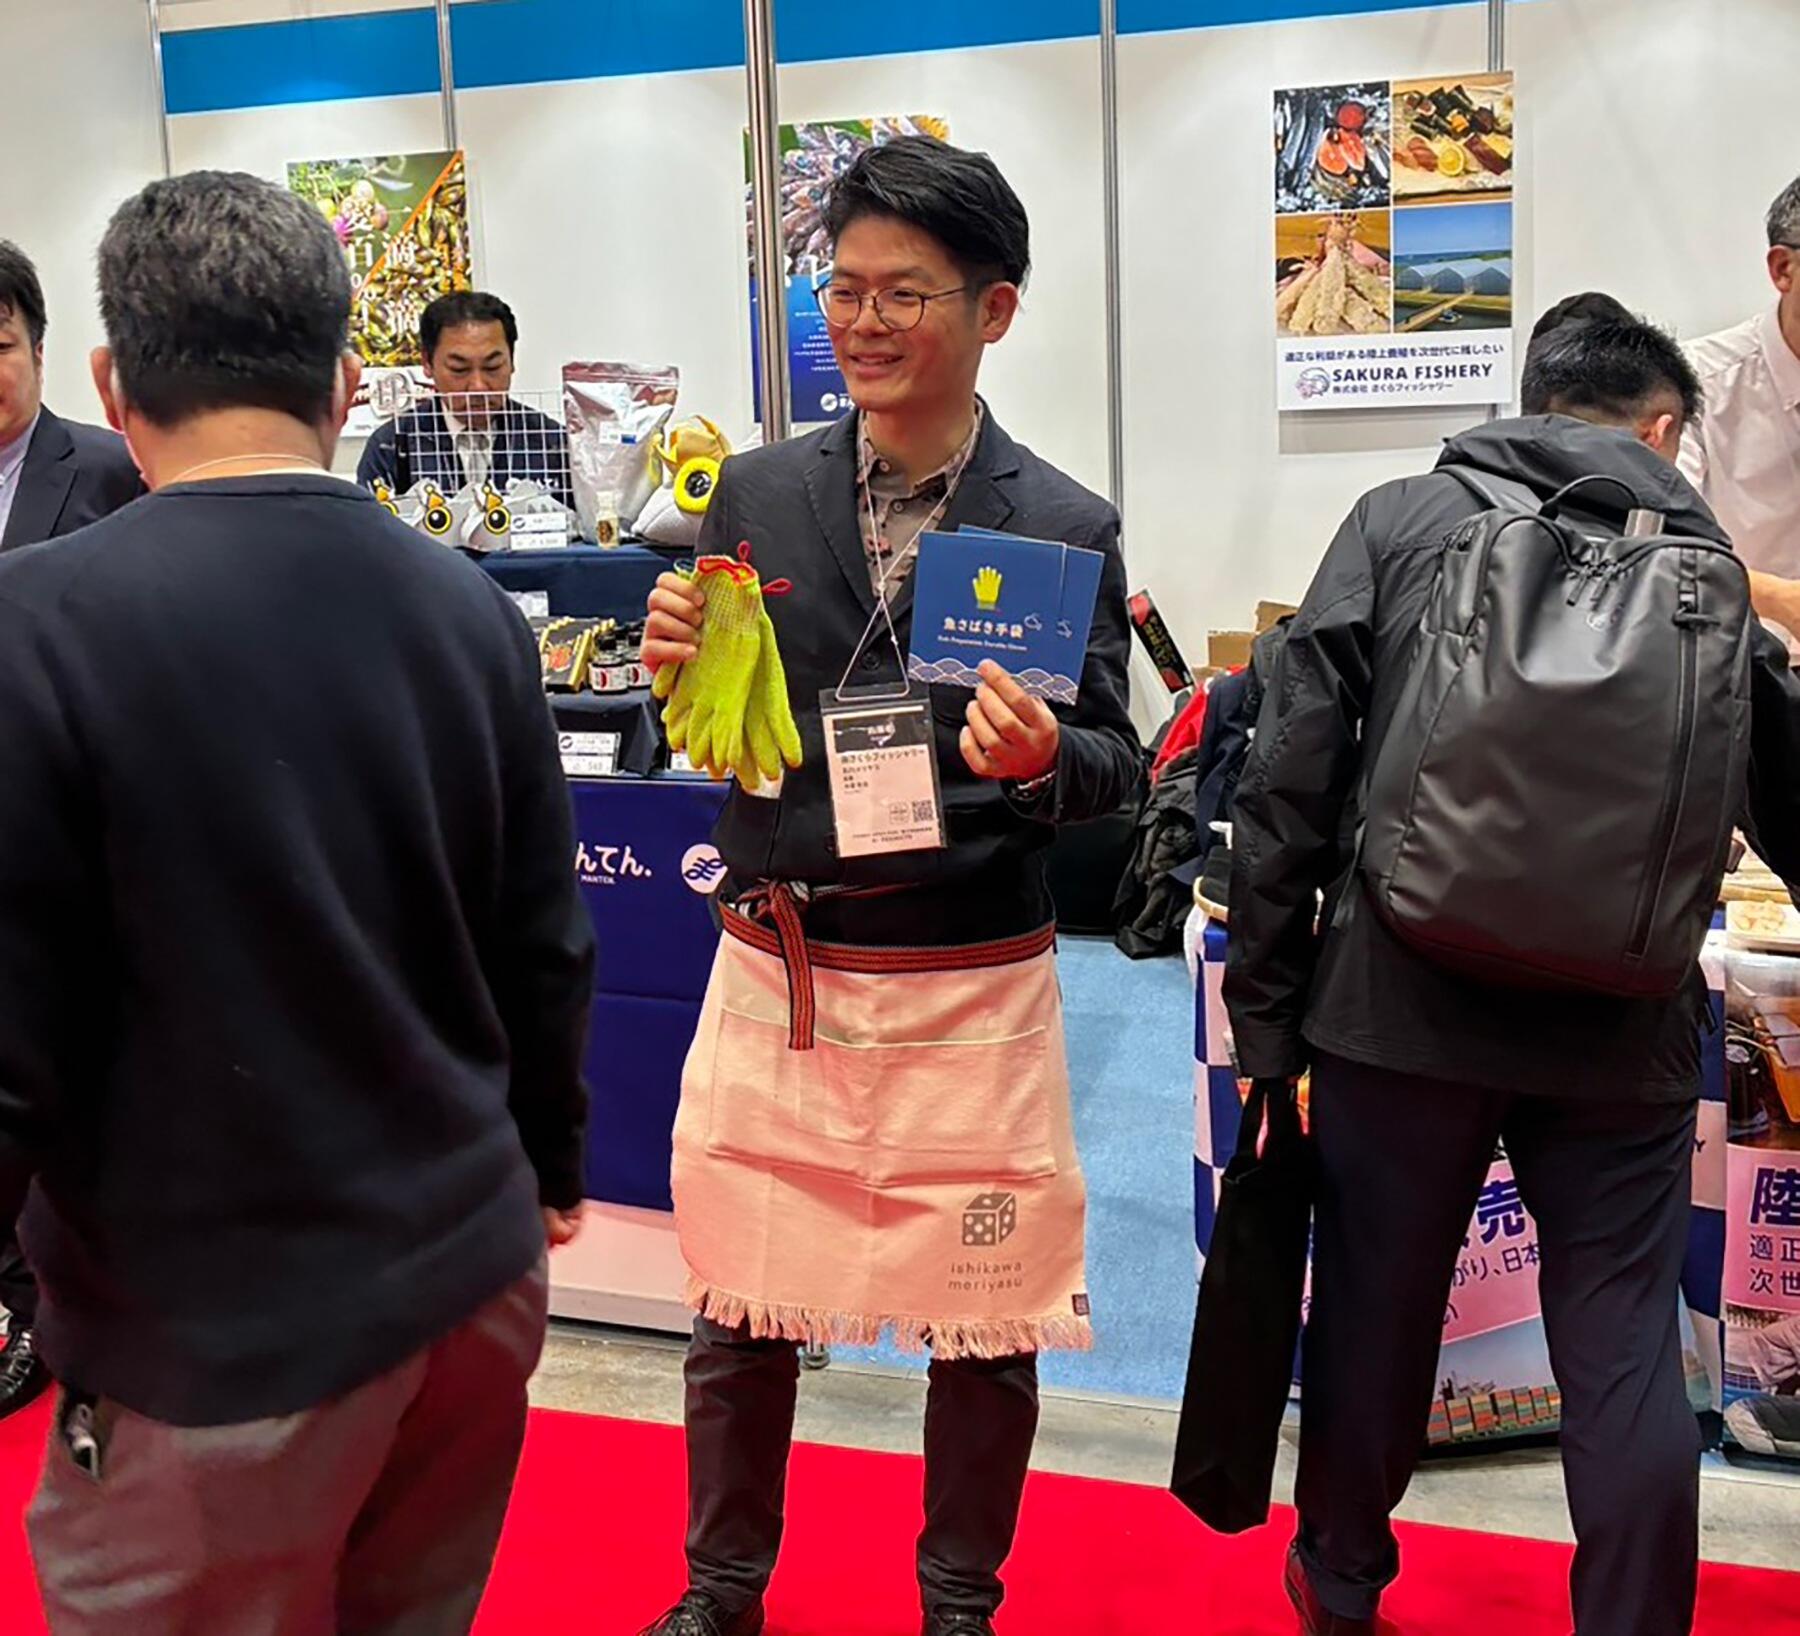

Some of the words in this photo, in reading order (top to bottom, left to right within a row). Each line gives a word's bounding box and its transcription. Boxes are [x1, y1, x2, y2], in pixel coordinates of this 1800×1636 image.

[1333, 367, 1408, 382] SAKURA
[1415, 363, 1493, 379] FISHERY
[1333, 384, 1368, 394] 株式会社
[1462, 1179, 1526, 1249] 売
[1750, 1234, 1800, 1263] 適正
[951, 1262, 1022, 1275] ishikawa
[1750, 1268, 1800, 1297] 次世
